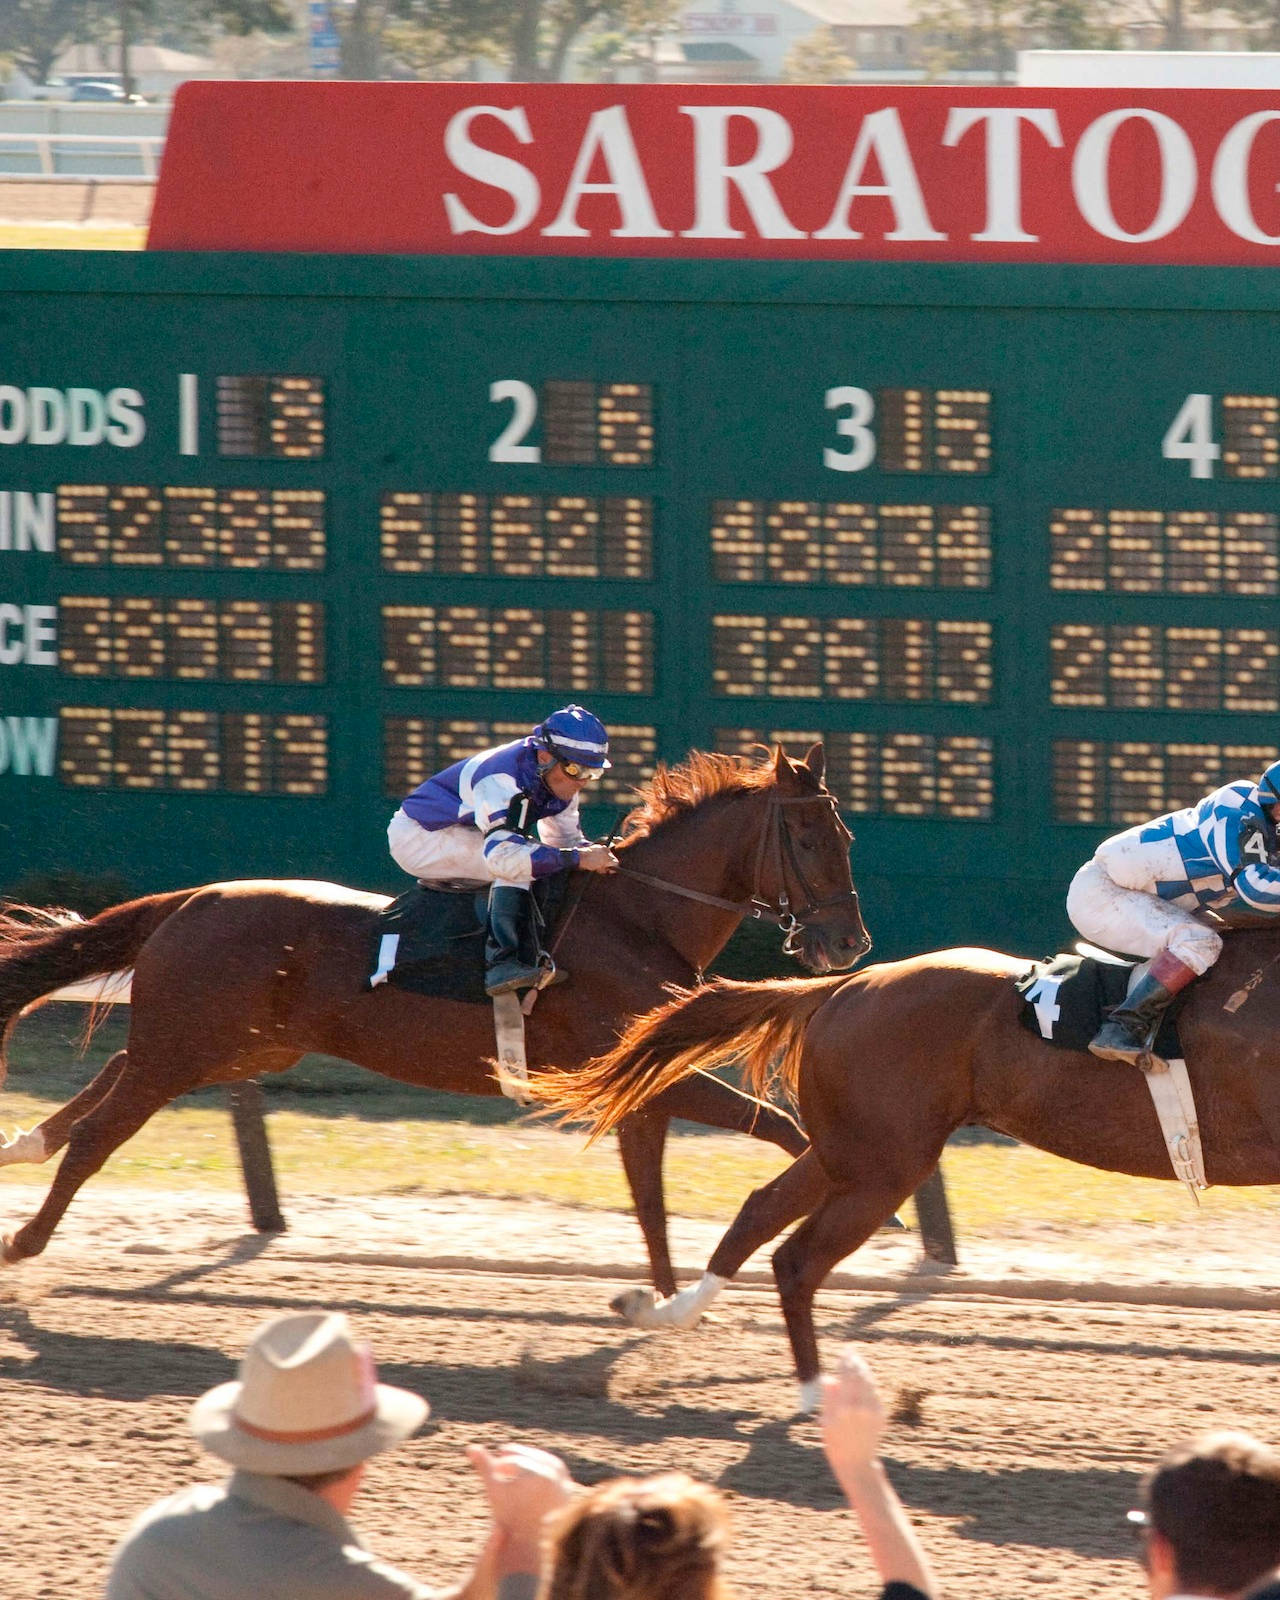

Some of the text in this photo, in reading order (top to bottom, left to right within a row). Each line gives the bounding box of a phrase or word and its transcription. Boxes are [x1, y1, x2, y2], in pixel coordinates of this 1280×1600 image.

[0, 385, 144, 447] ODDS
[274, 381, 321, 455] 8
[491, 380, 540, 463] 2
[602, 386, 649, 461] 6
[825, 386, 875, 471] 3
[907, 392, 987, 470] 15
[1163, 394, 1219, 478] 4
[58, 485, 326, 566] 52385
[381, 494, 641, 575] 61621
[714, 503, 987, 584] 48834
[60, 597, 313, 679] 38991
[383, 607, 641, 690] 39211
[717, 618, 987, 699] 32613
[60, 708, 328, 791] 33619
[517, 798, 529, 829] 1
[1245, 830, 1268, 863] 4
[1024, 975, 1064, 1039] 4
